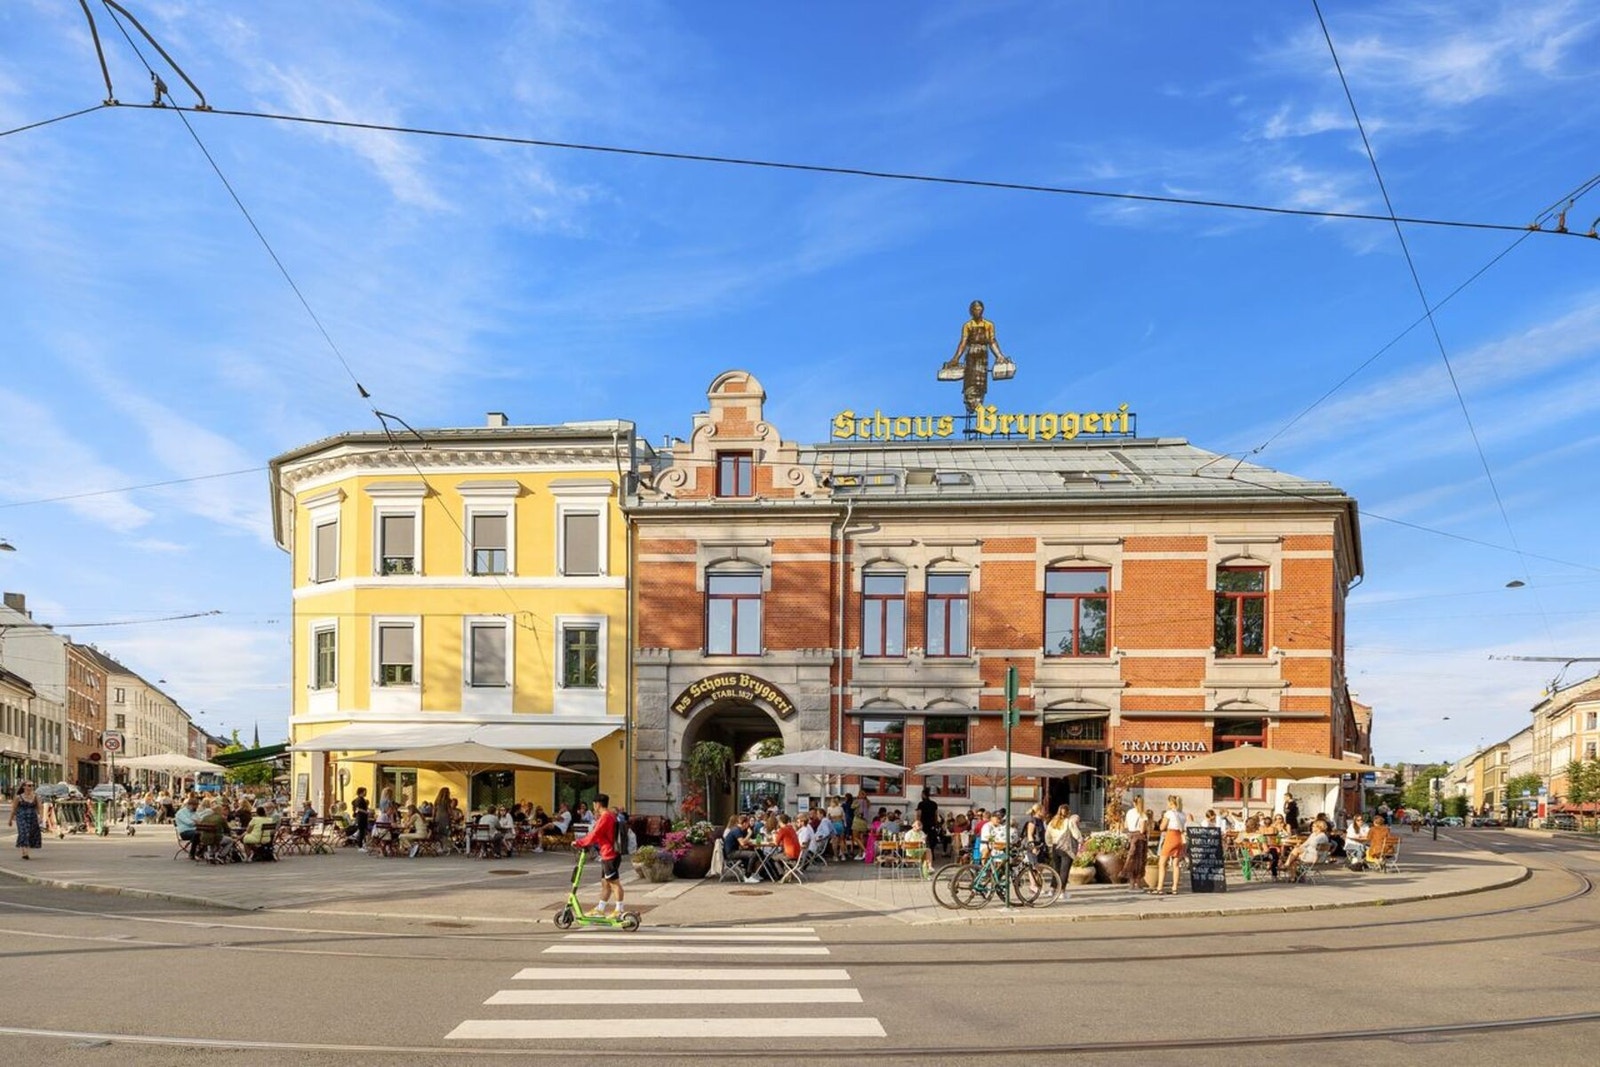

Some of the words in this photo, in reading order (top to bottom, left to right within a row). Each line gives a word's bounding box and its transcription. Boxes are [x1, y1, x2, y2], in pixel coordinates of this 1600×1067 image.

[832, 409, 955, 442] Schous
[975, 402, 1129, 441] Bryggeri
[690, 676, 737, 697] Schous
[739, 674, 793, 714] Bryggeri
[1121, 740, 1206, 751] TRATTORIA
